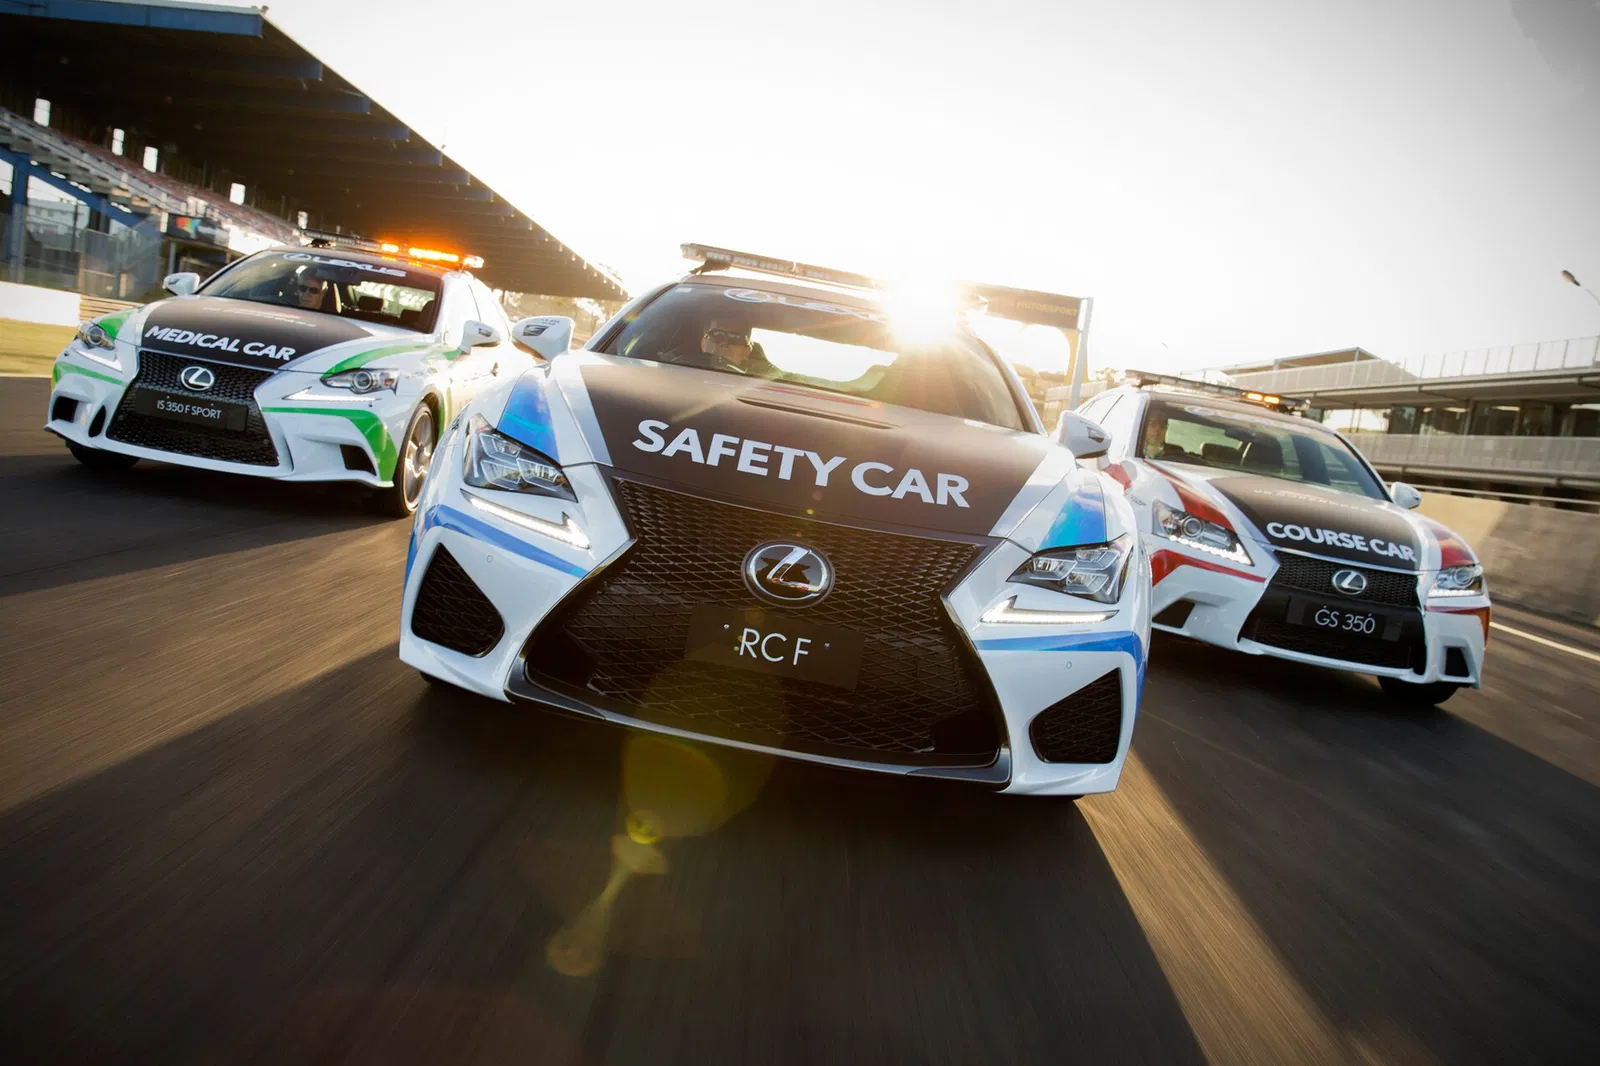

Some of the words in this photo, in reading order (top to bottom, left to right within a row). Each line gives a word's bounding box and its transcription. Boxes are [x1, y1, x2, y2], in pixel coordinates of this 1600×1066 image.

[312, 256, 407, 277] LEXUS
[776, 296, 889, 324] LEXU
[144, 325, 240, 353] MEDICAL
[242, 341, 296, 361] CAR
[156, 399, 165, 409] IS
[166, 400, 184, 413] 350
[184, 404, 191, 414] F
[191, 406, 222, 420] SPORT
[632, 419, 847, 487] SAFETY
[851, 461, 970, 508] CAR
[1266, 521, 1369, 552] COURSE
[1369, 538, 1417, 563] CAR
[1314, 608, 1340, 628] GS
[1342, 614, 1376, 634] 350
[739, 627, 787, 662] RC
[792, 637, 812, 666] F
